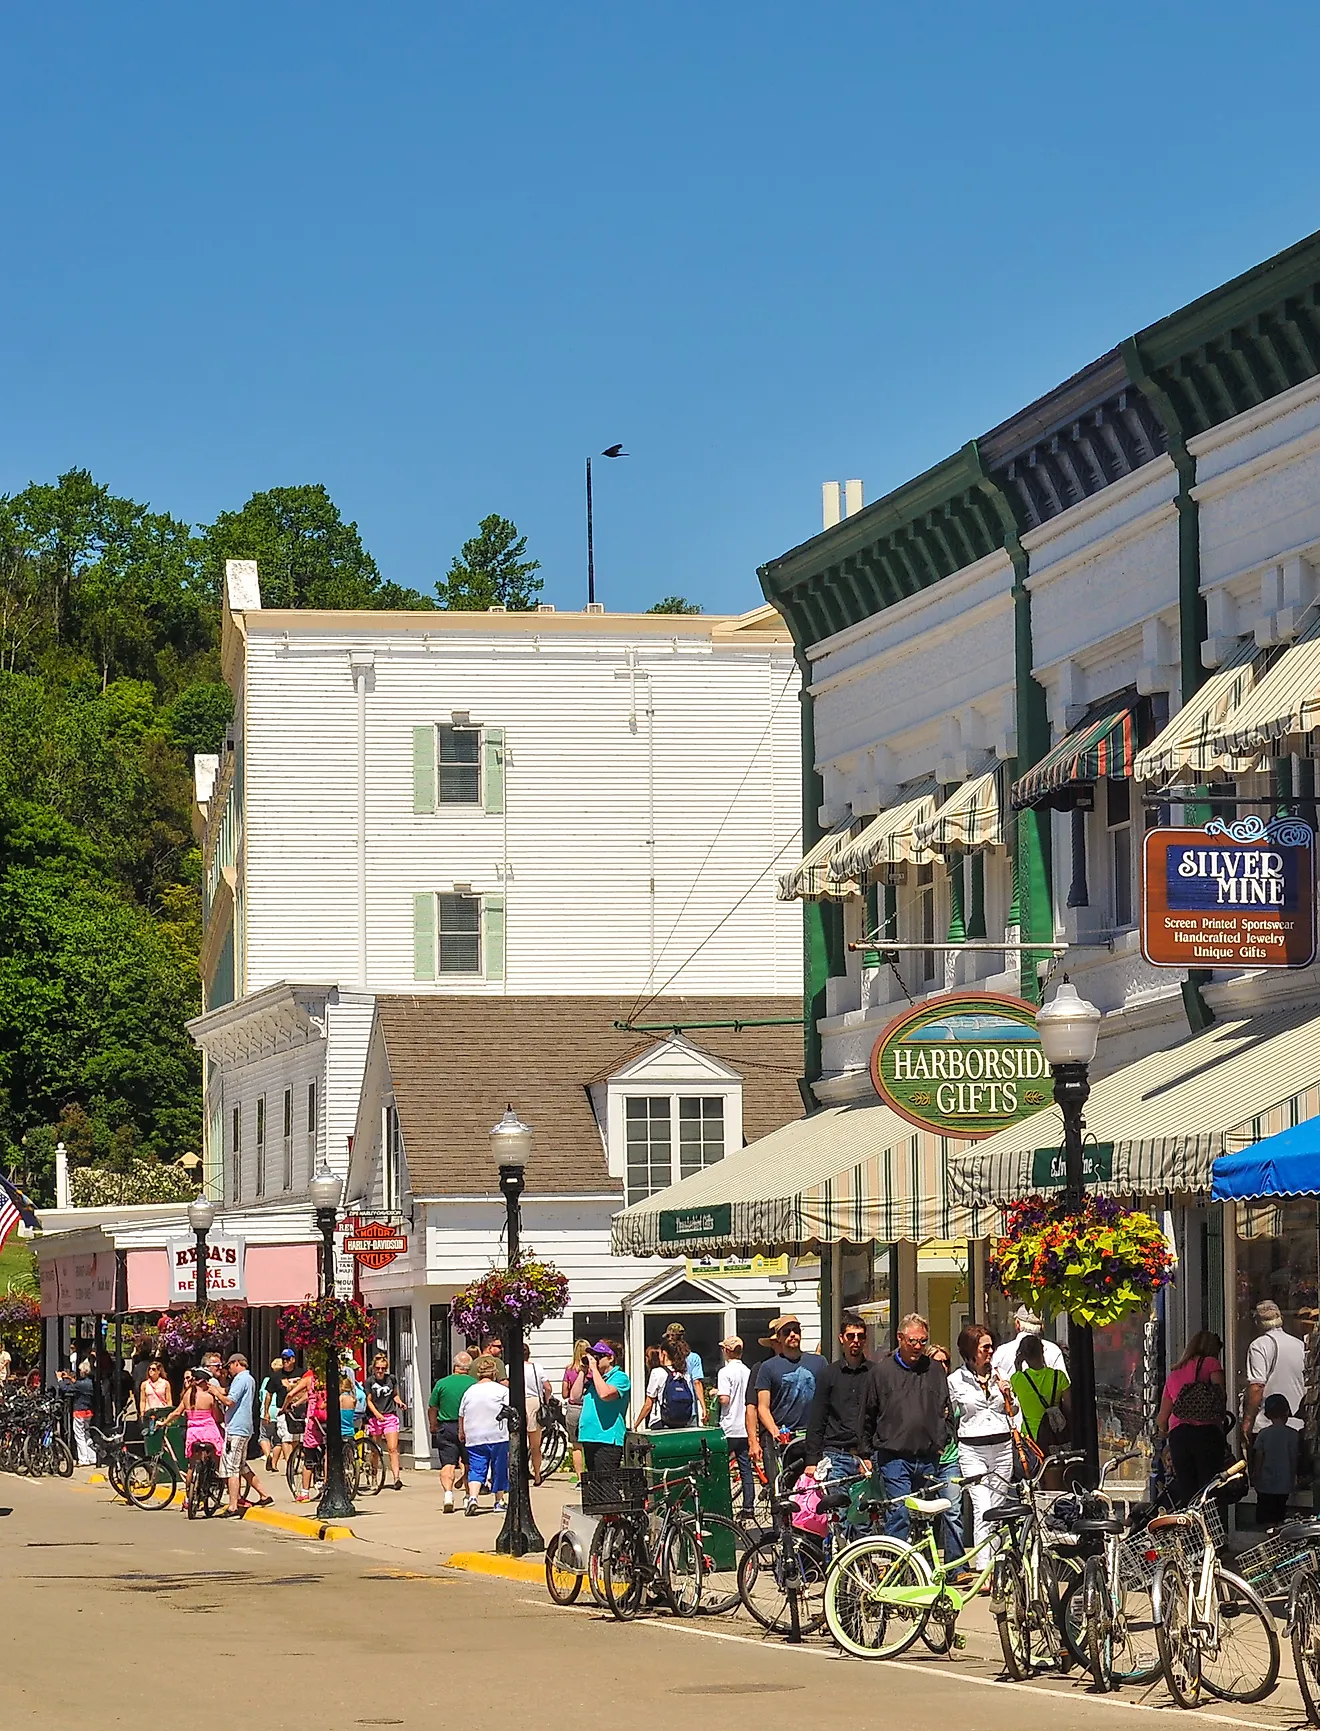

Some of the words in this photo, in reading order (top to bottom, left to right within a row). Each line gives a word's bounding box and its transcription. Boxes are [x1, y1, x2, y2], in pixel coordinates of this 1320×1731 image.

[1178, 850, 1285, 879] SILVER
[1216, 877, 1285, 906] MINE
[1164, 917, 1197, 929] Screen
[1202, 917, 1237, 929] Printed
[1241, 918, 1295, 931] Sportswear
[1174, 931, 1241, 944] Handcrafted
[1246, 932, 1285, 946] Jewelry
[1194, 945, 1234, 960] Unique
[1239, 945, 1267, 958] Gifts
[936, 1082, 1018, 1114] GIFTS
[360, 1225, 391, 1237] MOTOR
[347, 1239, 404, 1251] HARLEY-DAVIDSON
[360, 1253, 392, 1266] CYCLES
[191, 1268, 222, 1280] BKE
[177, 1278, 237, 1291] RETALS
